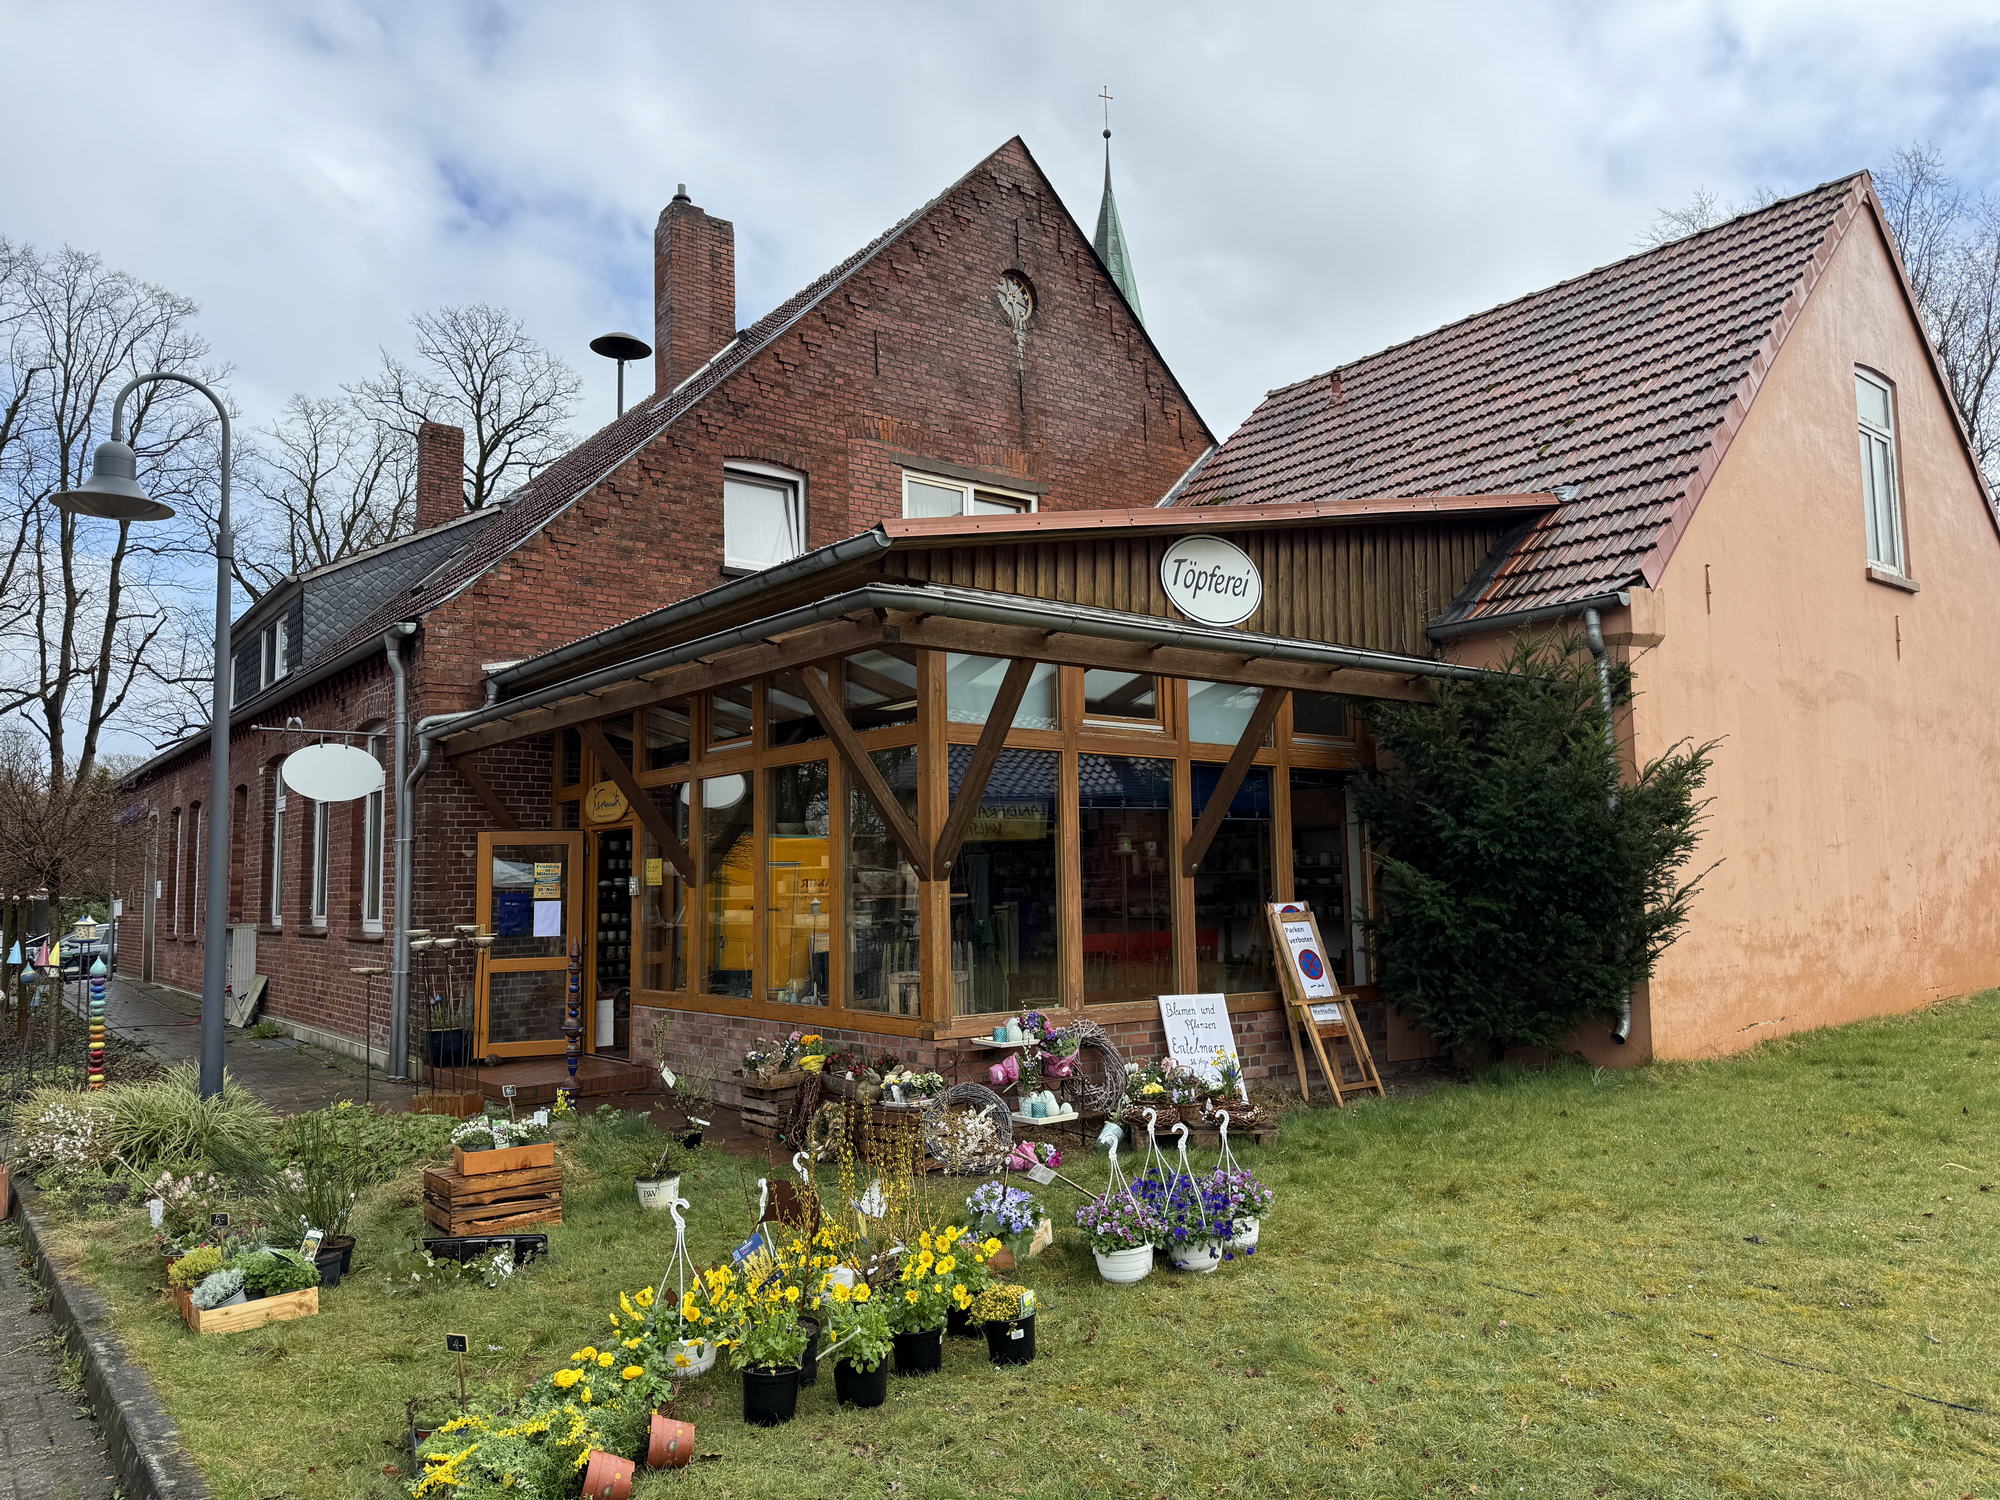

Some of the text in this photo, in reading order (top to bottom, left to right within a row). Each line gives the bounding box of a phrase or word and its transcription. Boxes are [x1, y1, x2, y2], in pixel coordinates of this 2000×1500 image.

[1173, 558, 1251, 600] Töpferei
[1285, 926, 1305, 934] Parken
[1289, 936, 1314, 944] verboten
[1165, 1002, 1216, 1018] Blumen und
[1184, 1018, 1217, 1035] Pflanzen
